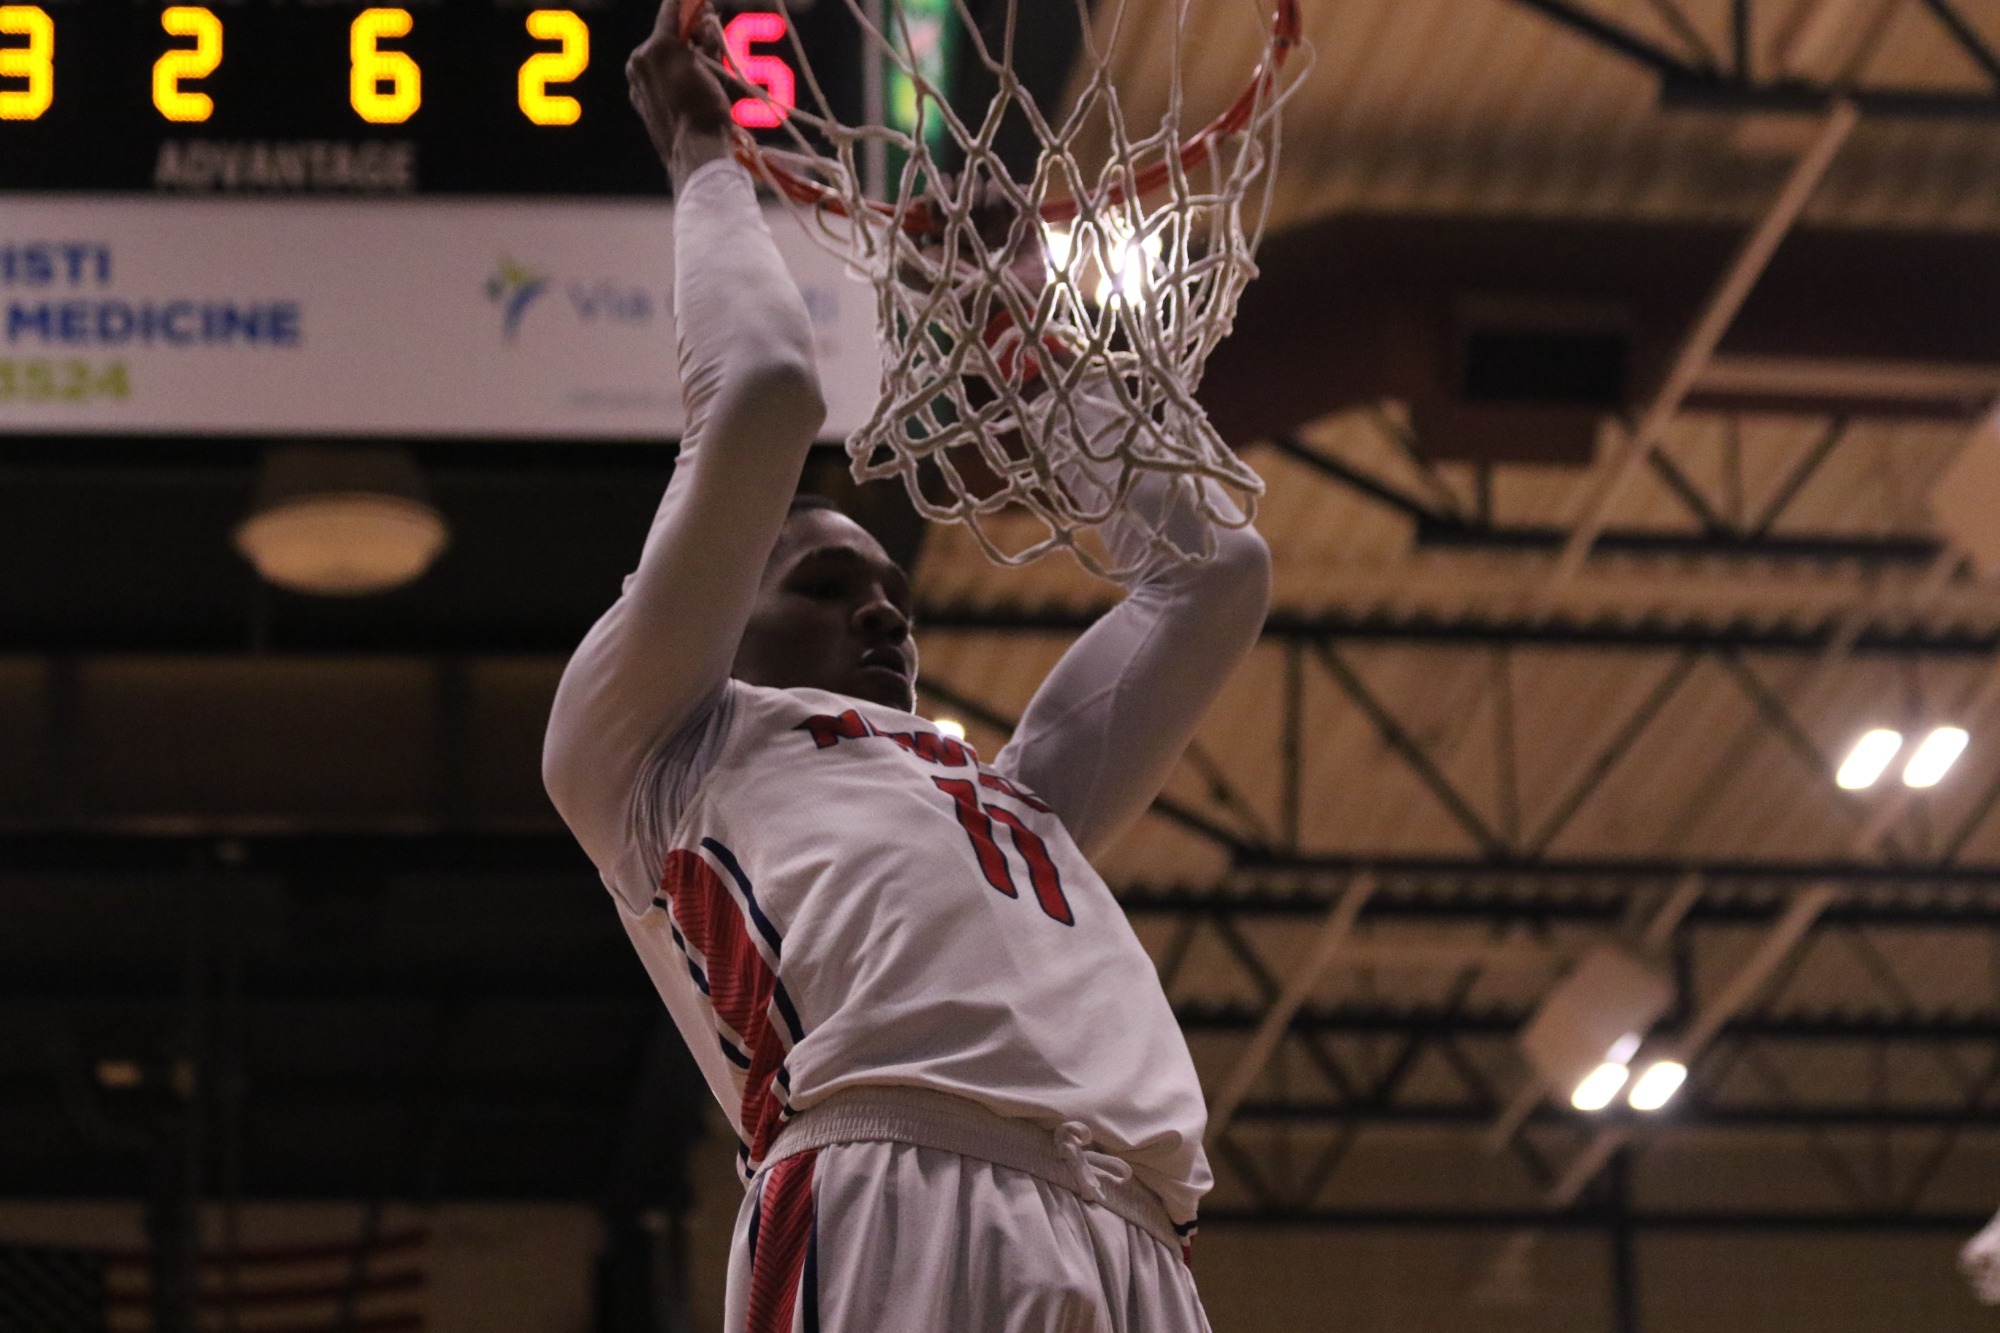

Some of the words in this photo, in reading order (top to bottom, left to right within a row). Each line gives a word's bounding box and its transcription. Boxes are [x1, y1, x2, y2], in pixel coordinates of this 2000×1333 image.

[0, 5, 54, 121] 3
[152, 5, 223, 122] 2
[350, 7, 422, 124] 6
[517, 9, 590, 126] 2
[722, 12, 795, 128] 5
[156, 141, 416, 187] ADVANTAGE
[0, 243, 112, 285] ISTI
[7, 301, 301, 346] MEDICINE
[931, 774, 1075, 927] 11
